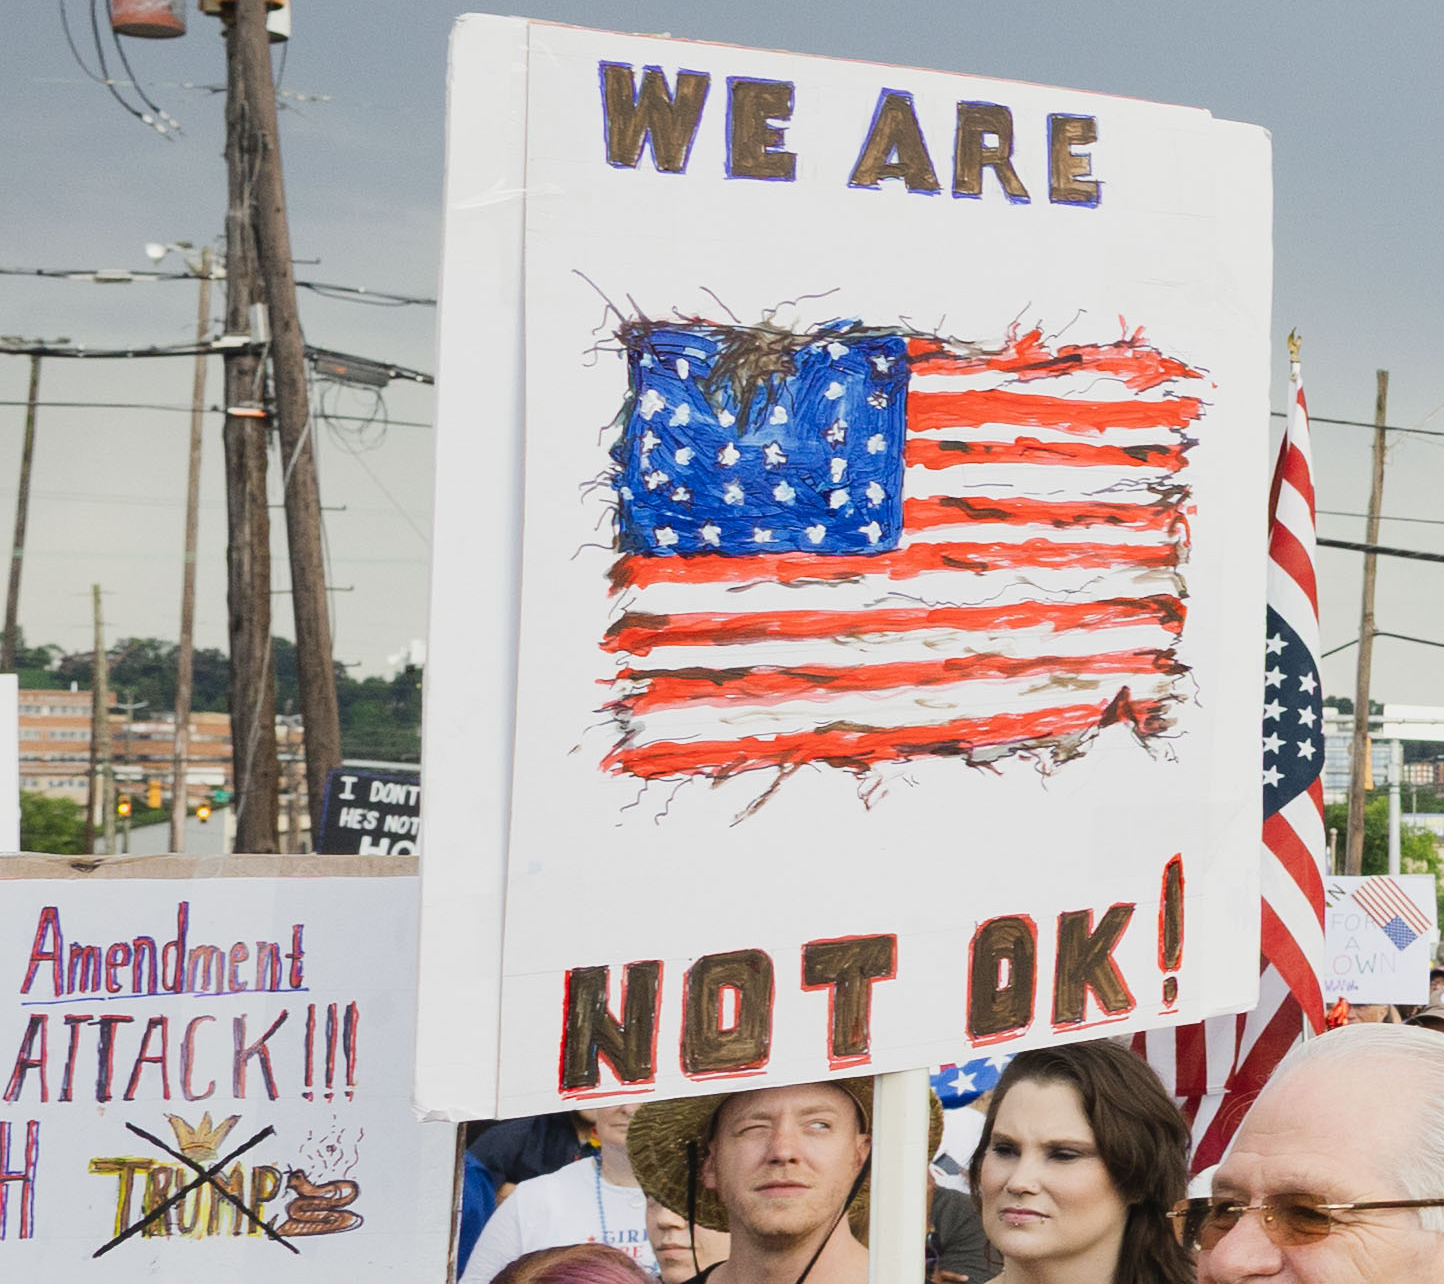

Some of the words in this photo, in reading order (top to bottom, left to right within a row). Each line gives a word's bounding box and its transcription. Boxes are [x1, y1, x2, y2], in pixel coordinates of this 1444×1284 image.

[600, 60, 797, 181] WE
[849, 88, 1102, 208] ARE
[339, 775, 358, 800] I
[384, 815, 420, 835] NOT
[21, 901, 307, 997] Amendment
[559, 934, 897, 1099] NOT
[963, 853, 1186, 1048] OK!
[3, 1001, 359, 1103] ATTACK!!!
